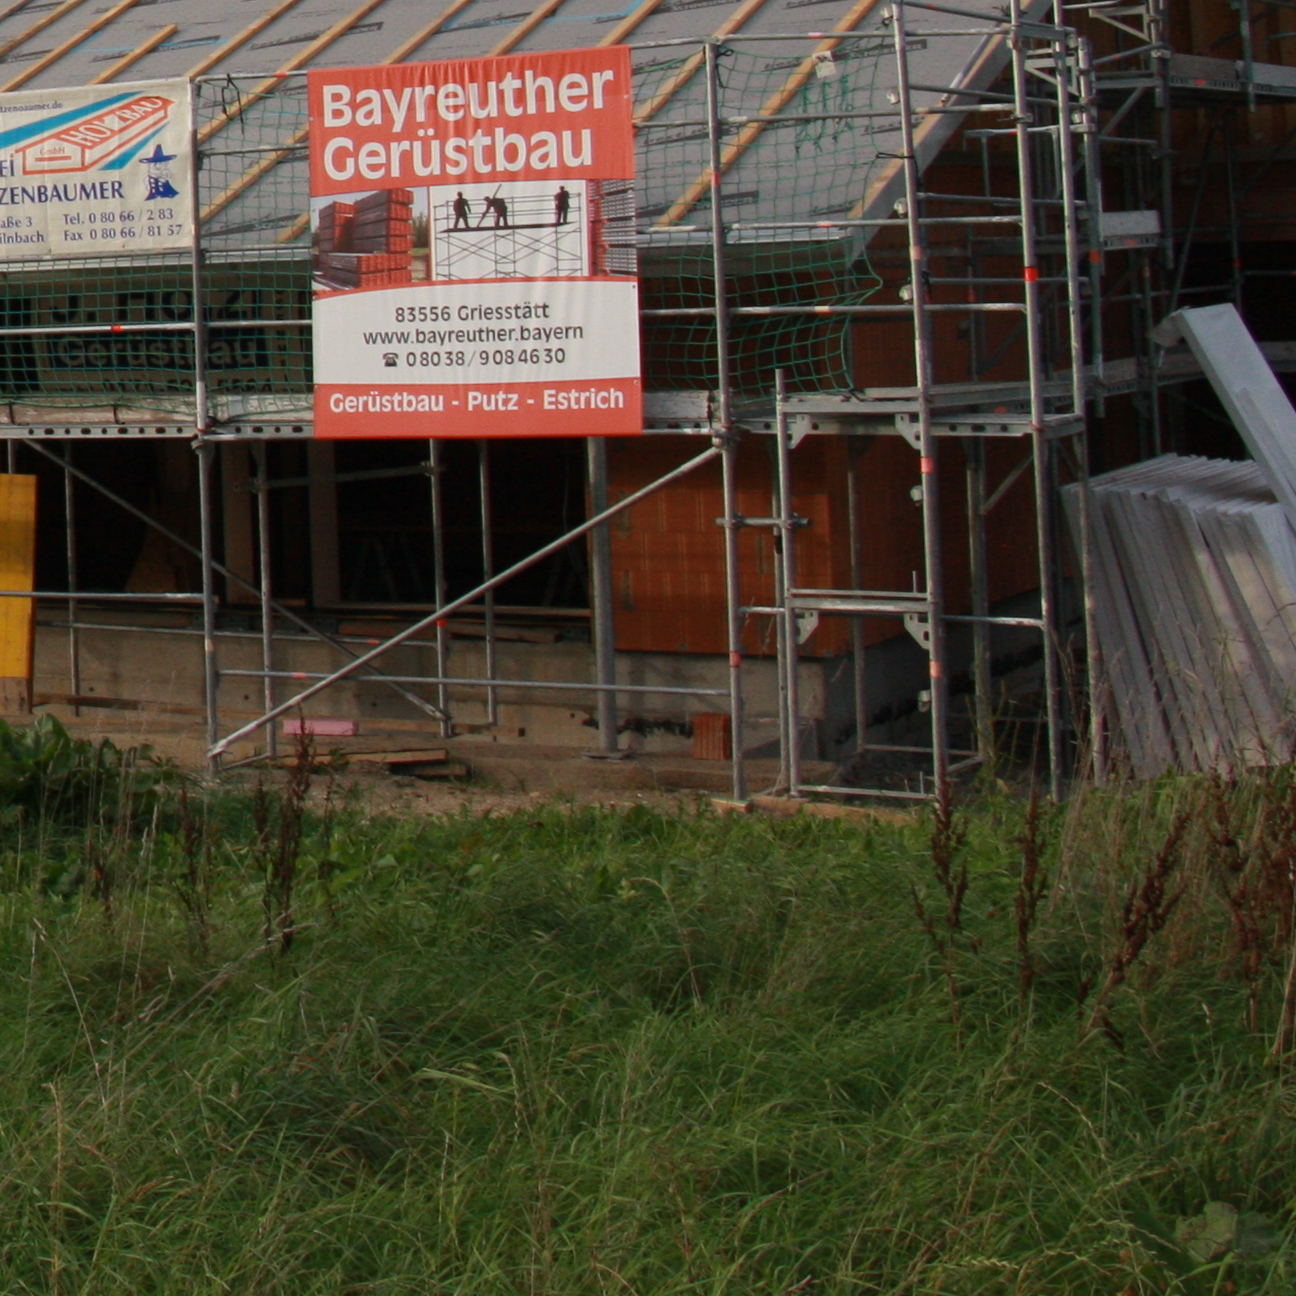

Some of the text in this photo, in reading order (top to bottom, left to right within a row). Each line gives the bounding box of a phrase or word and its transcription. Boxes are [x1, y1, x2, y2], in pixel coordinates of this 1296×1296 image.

[322, 69, 614, 133] Bayreuther
[323, 126, 593, 181] Gerüstbau
[25, 216, 33, 228] 3
[63, 212, 85, 225] Tel.
[88, 212, 96, 223] 0
[100, 211, 115, 223] 80
[119, 210, 135, 222] 66
[146, 209, 155, 221] 2
[158, 208, 174, 220] 83
[63, 229, 83, 241] Fax
[89, 228, 97, 240] 0
[101, 228, 116, 239] 80
[120, 227, 136, 238] 66
[147, 225, 162, 237] 81
[167, 224, 183, 236] 57
[394, 301, 550, 323] 83556 Griesstätt
[363, 324, 584, 346] www.bayreuther.bayern
[329, 390, 444, 413] Gerüstbau
[467, 389, 520, 412] Putz
[543, 387, 624, 410] Estrich
